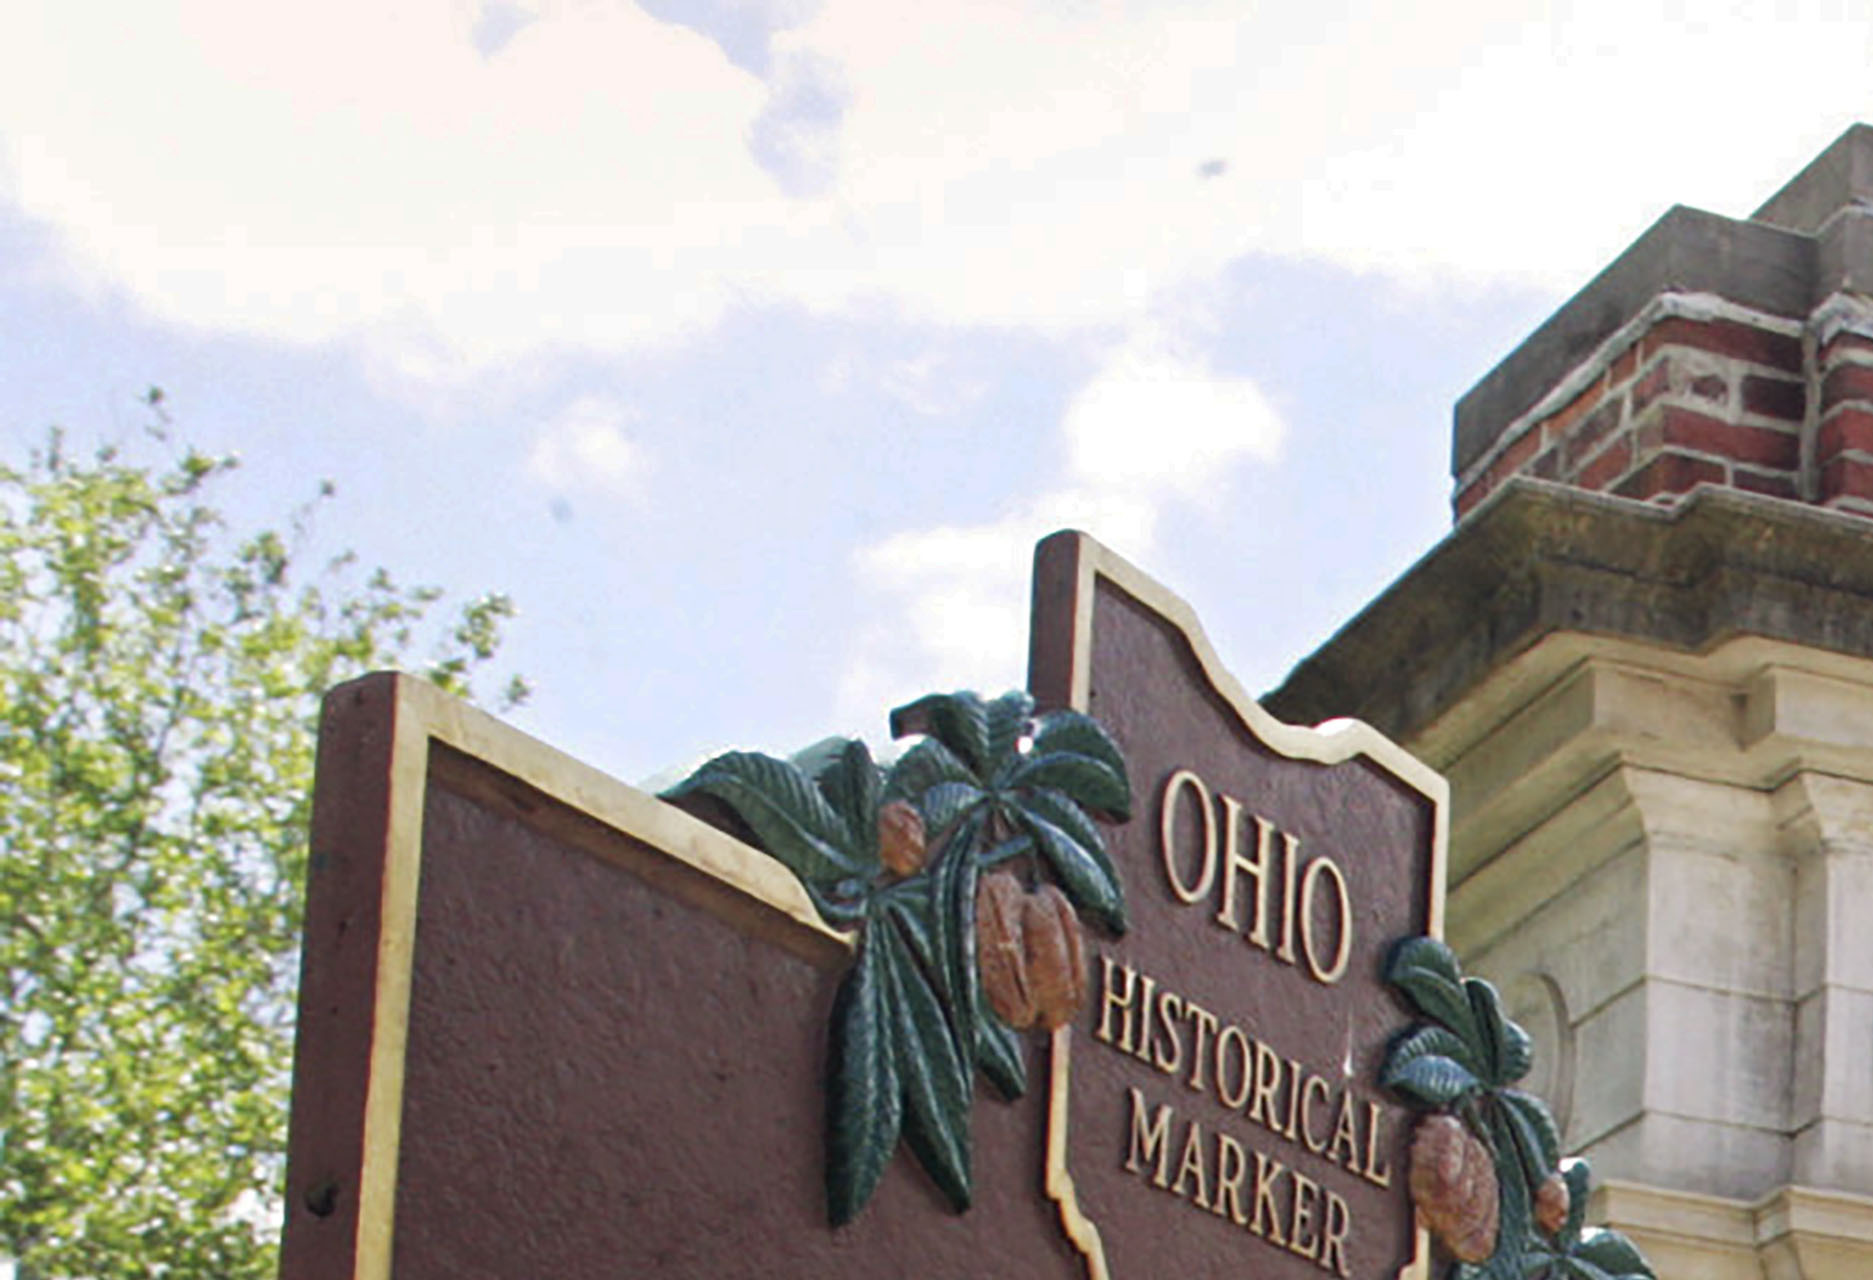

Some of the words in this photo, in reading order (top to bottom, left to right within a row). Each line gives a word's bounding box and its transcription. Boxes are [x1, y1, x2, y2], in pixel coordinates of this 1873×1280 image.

[1161, 769, 1353, 985] OHIO
[1096, 955, 1392, 1189] HISTORICAL
[1124, 1087, 1353, 1279] MARKER
